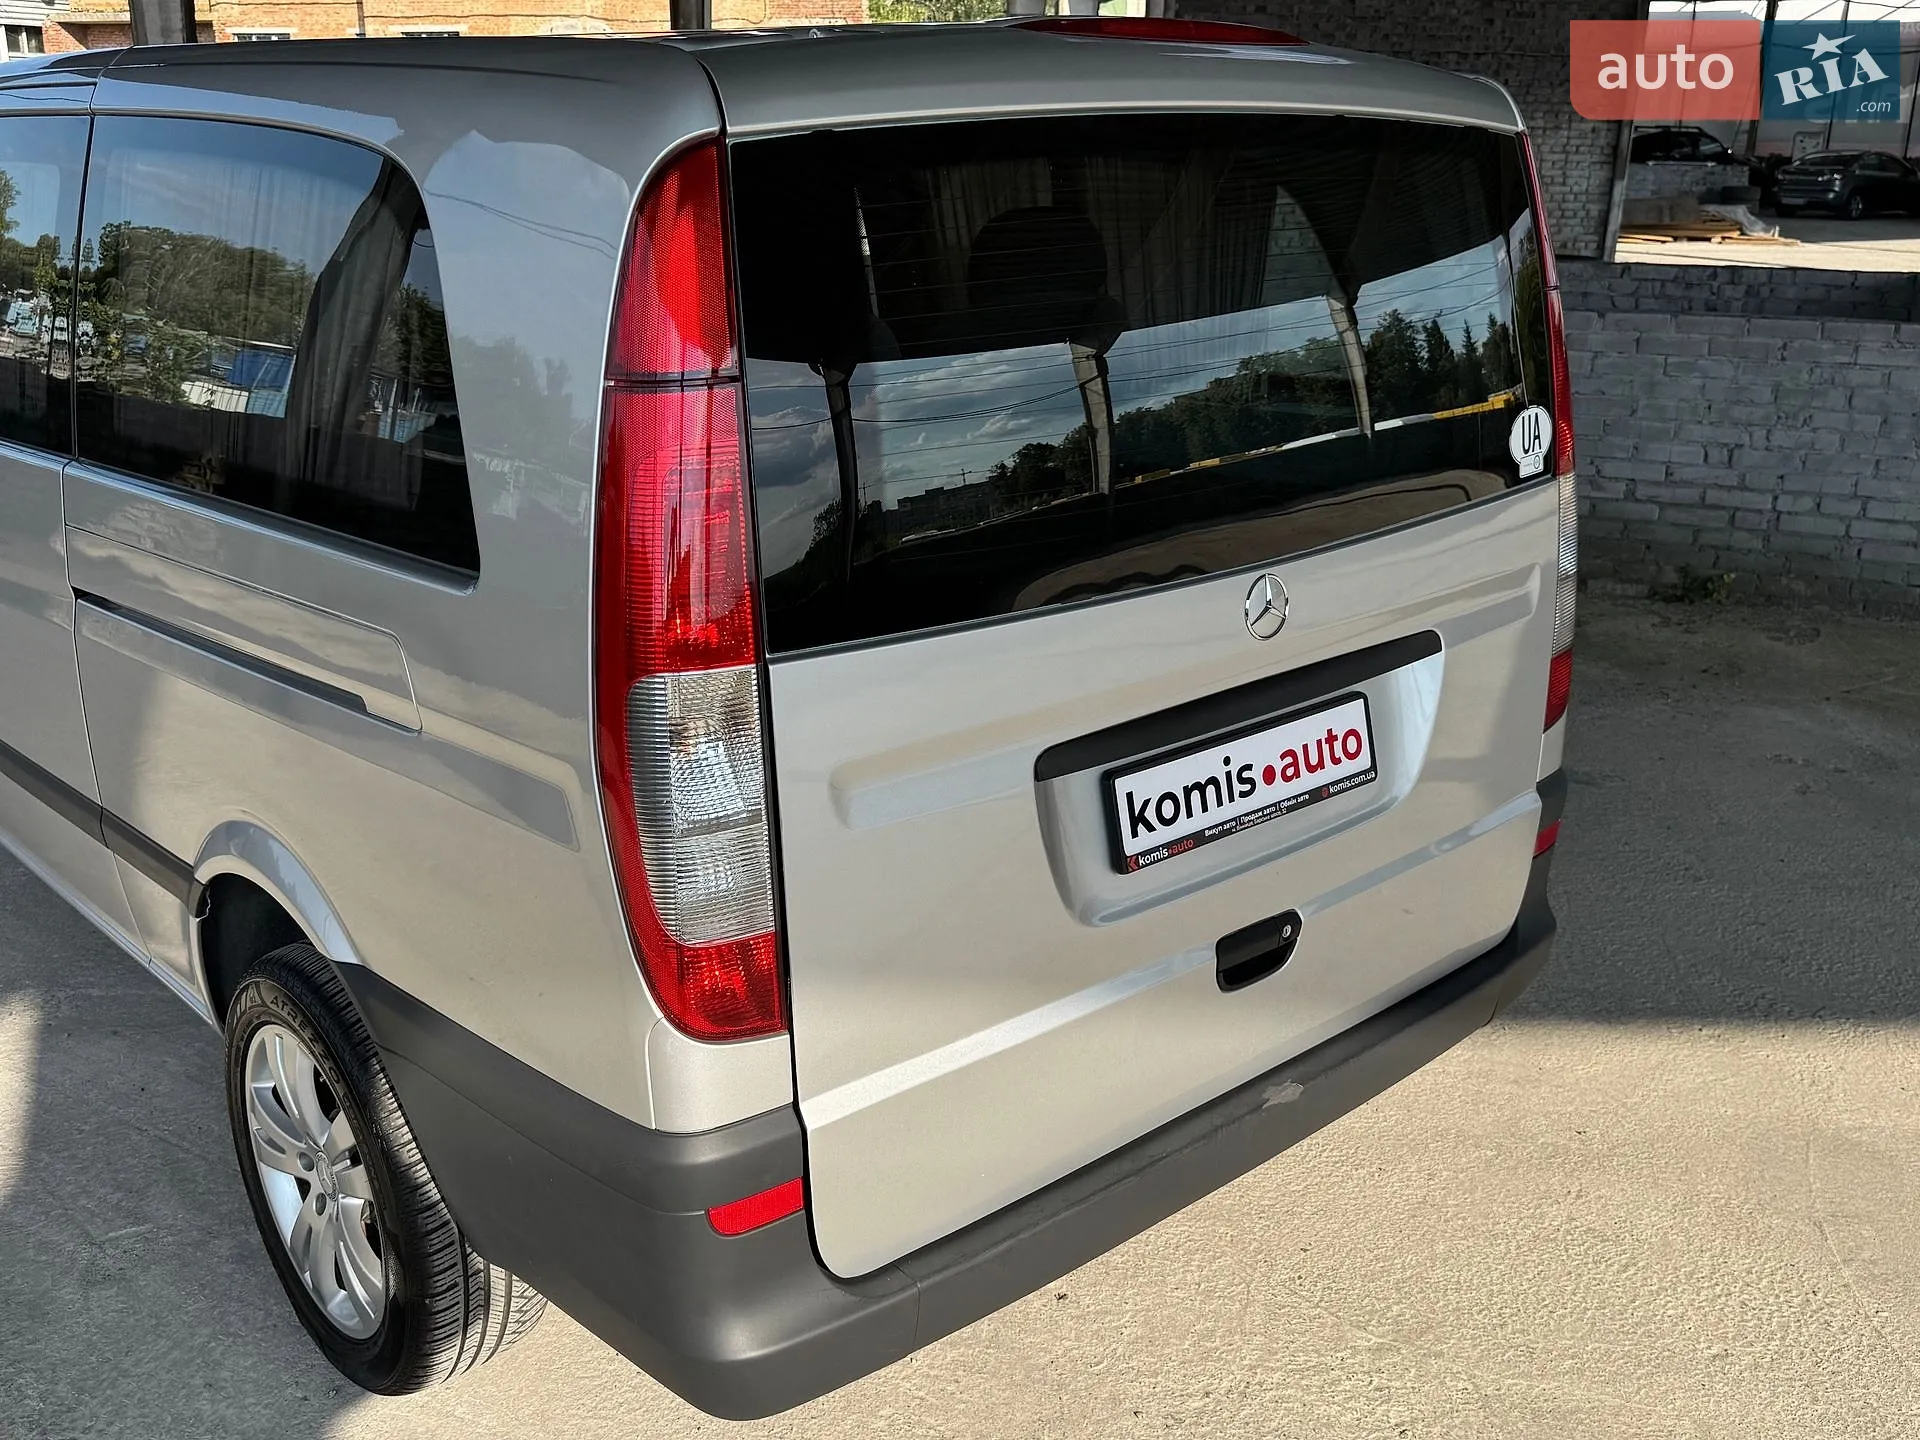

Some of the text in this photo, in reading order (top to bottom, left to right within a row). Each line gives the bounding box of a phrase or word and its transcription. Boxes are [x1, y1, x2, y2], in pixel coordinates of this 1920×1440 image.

[1522, 412, 1542, 455] UA
[1329, 771, 1375, 793] komis.com.ua
[1204, 825, 1223, 837] Викуп
[1223, 821, 1236, 830] авто
[1240, 812, 1263, 823] Продаж
[1263, 806, 1276, 815] авто
[1297, 793, 1309, 803] авто
[270, 994, 342, 1084] ATREZZO
